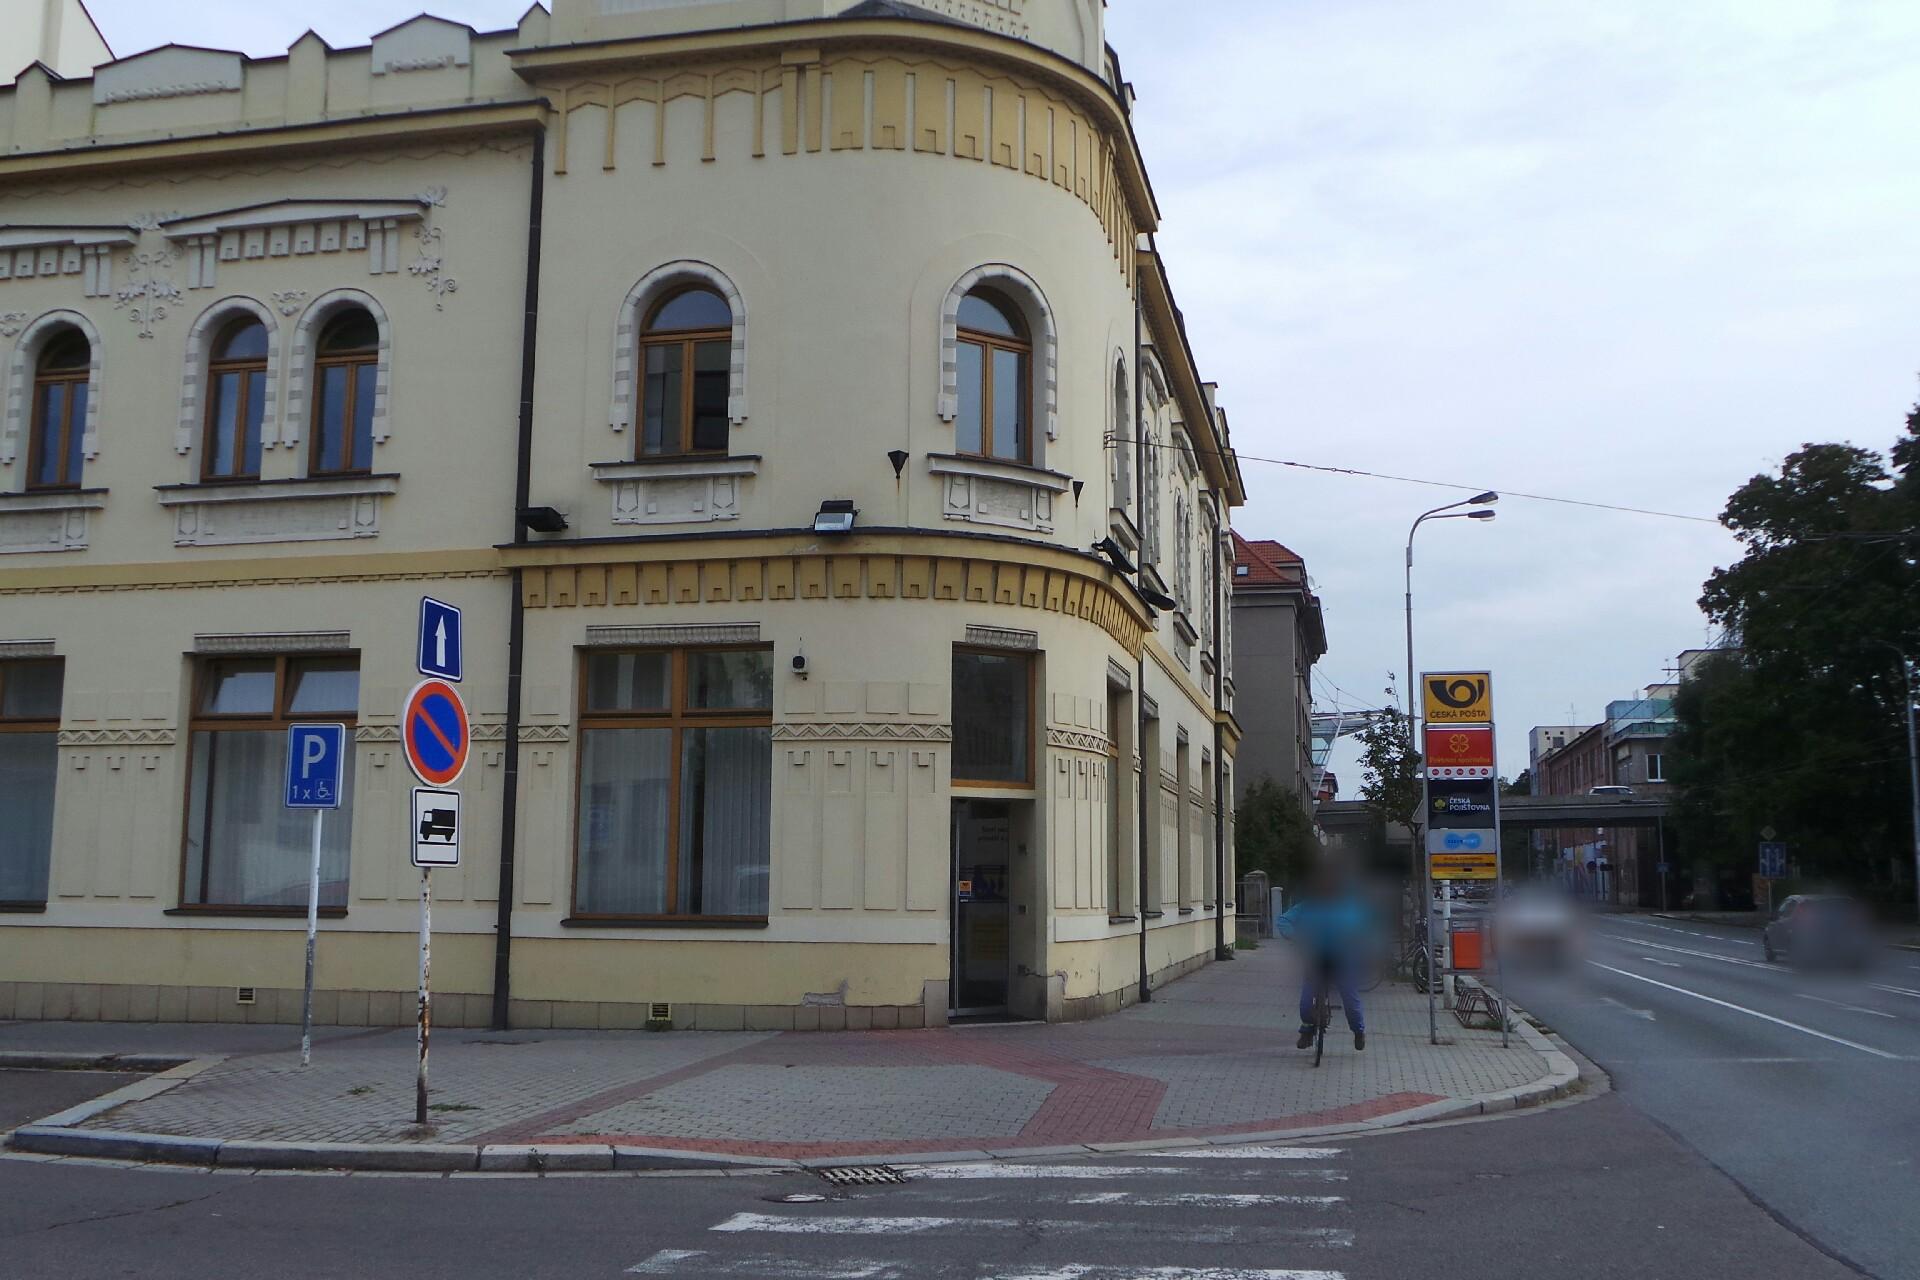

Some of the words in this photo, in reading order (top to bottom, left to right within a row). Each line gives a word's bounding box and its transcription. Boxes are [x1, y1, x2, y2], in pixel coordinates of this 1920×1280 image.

[1430, 709, 1457, 718] ČESKÁ
[1460, 709, 1487, 718] POŠTA
[302, 734, 327, 779] P
[293, 785, 298, 799] 1
